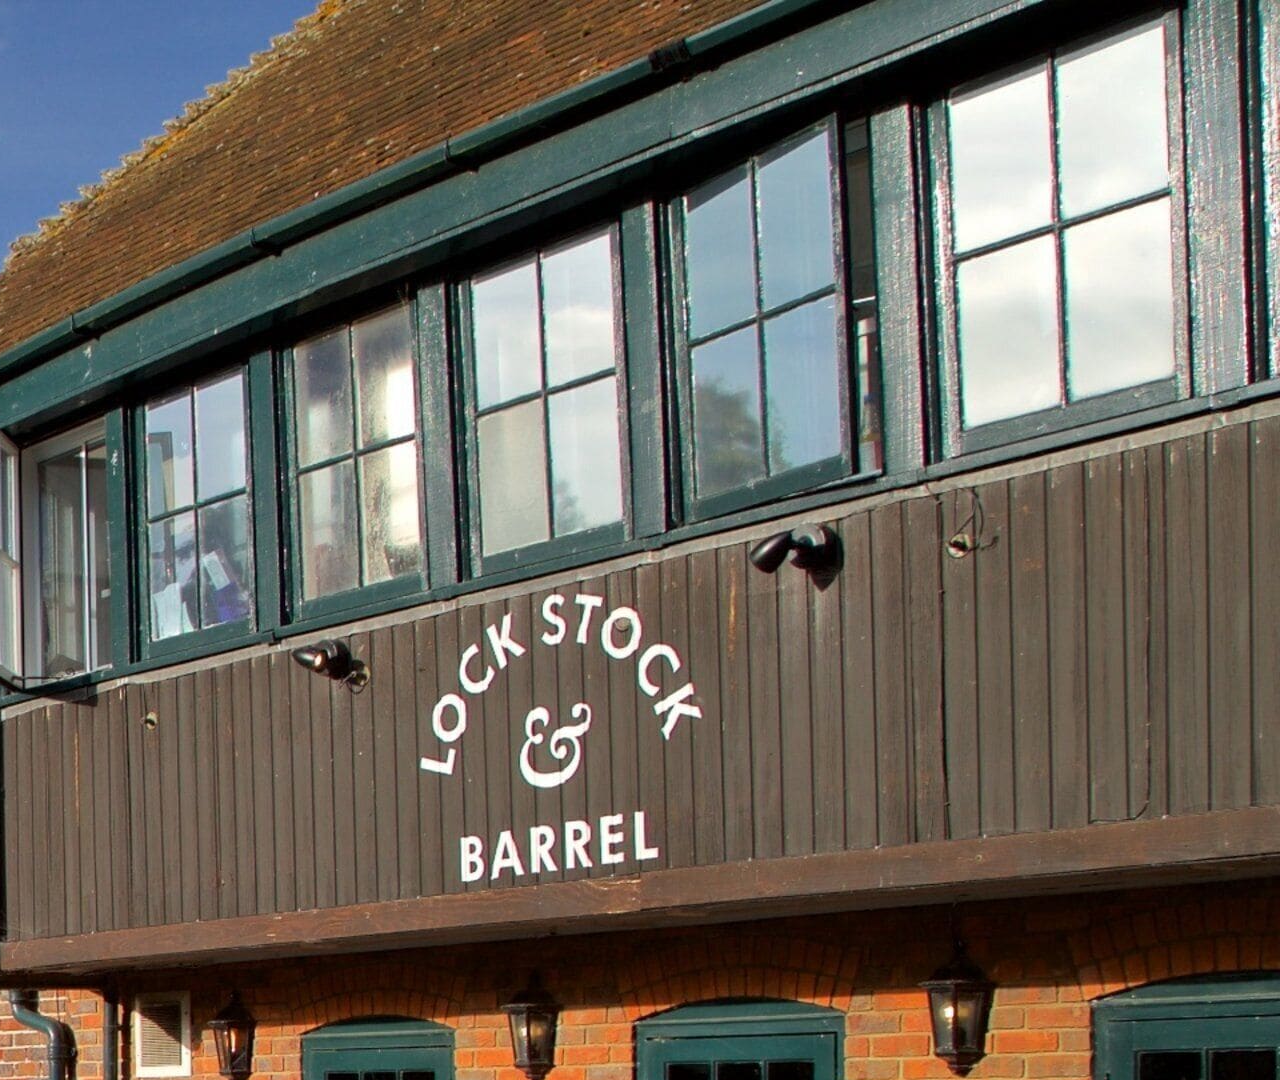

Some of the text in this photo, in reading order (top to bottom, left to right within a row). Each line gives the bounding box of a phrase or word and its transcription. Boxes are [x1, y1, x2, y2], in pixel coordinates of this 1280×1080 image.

[420, 593, 703, 776] LOCK STOCK
[519, 702, 592, 788] &
[460, 811, 659, 882] BARREL
